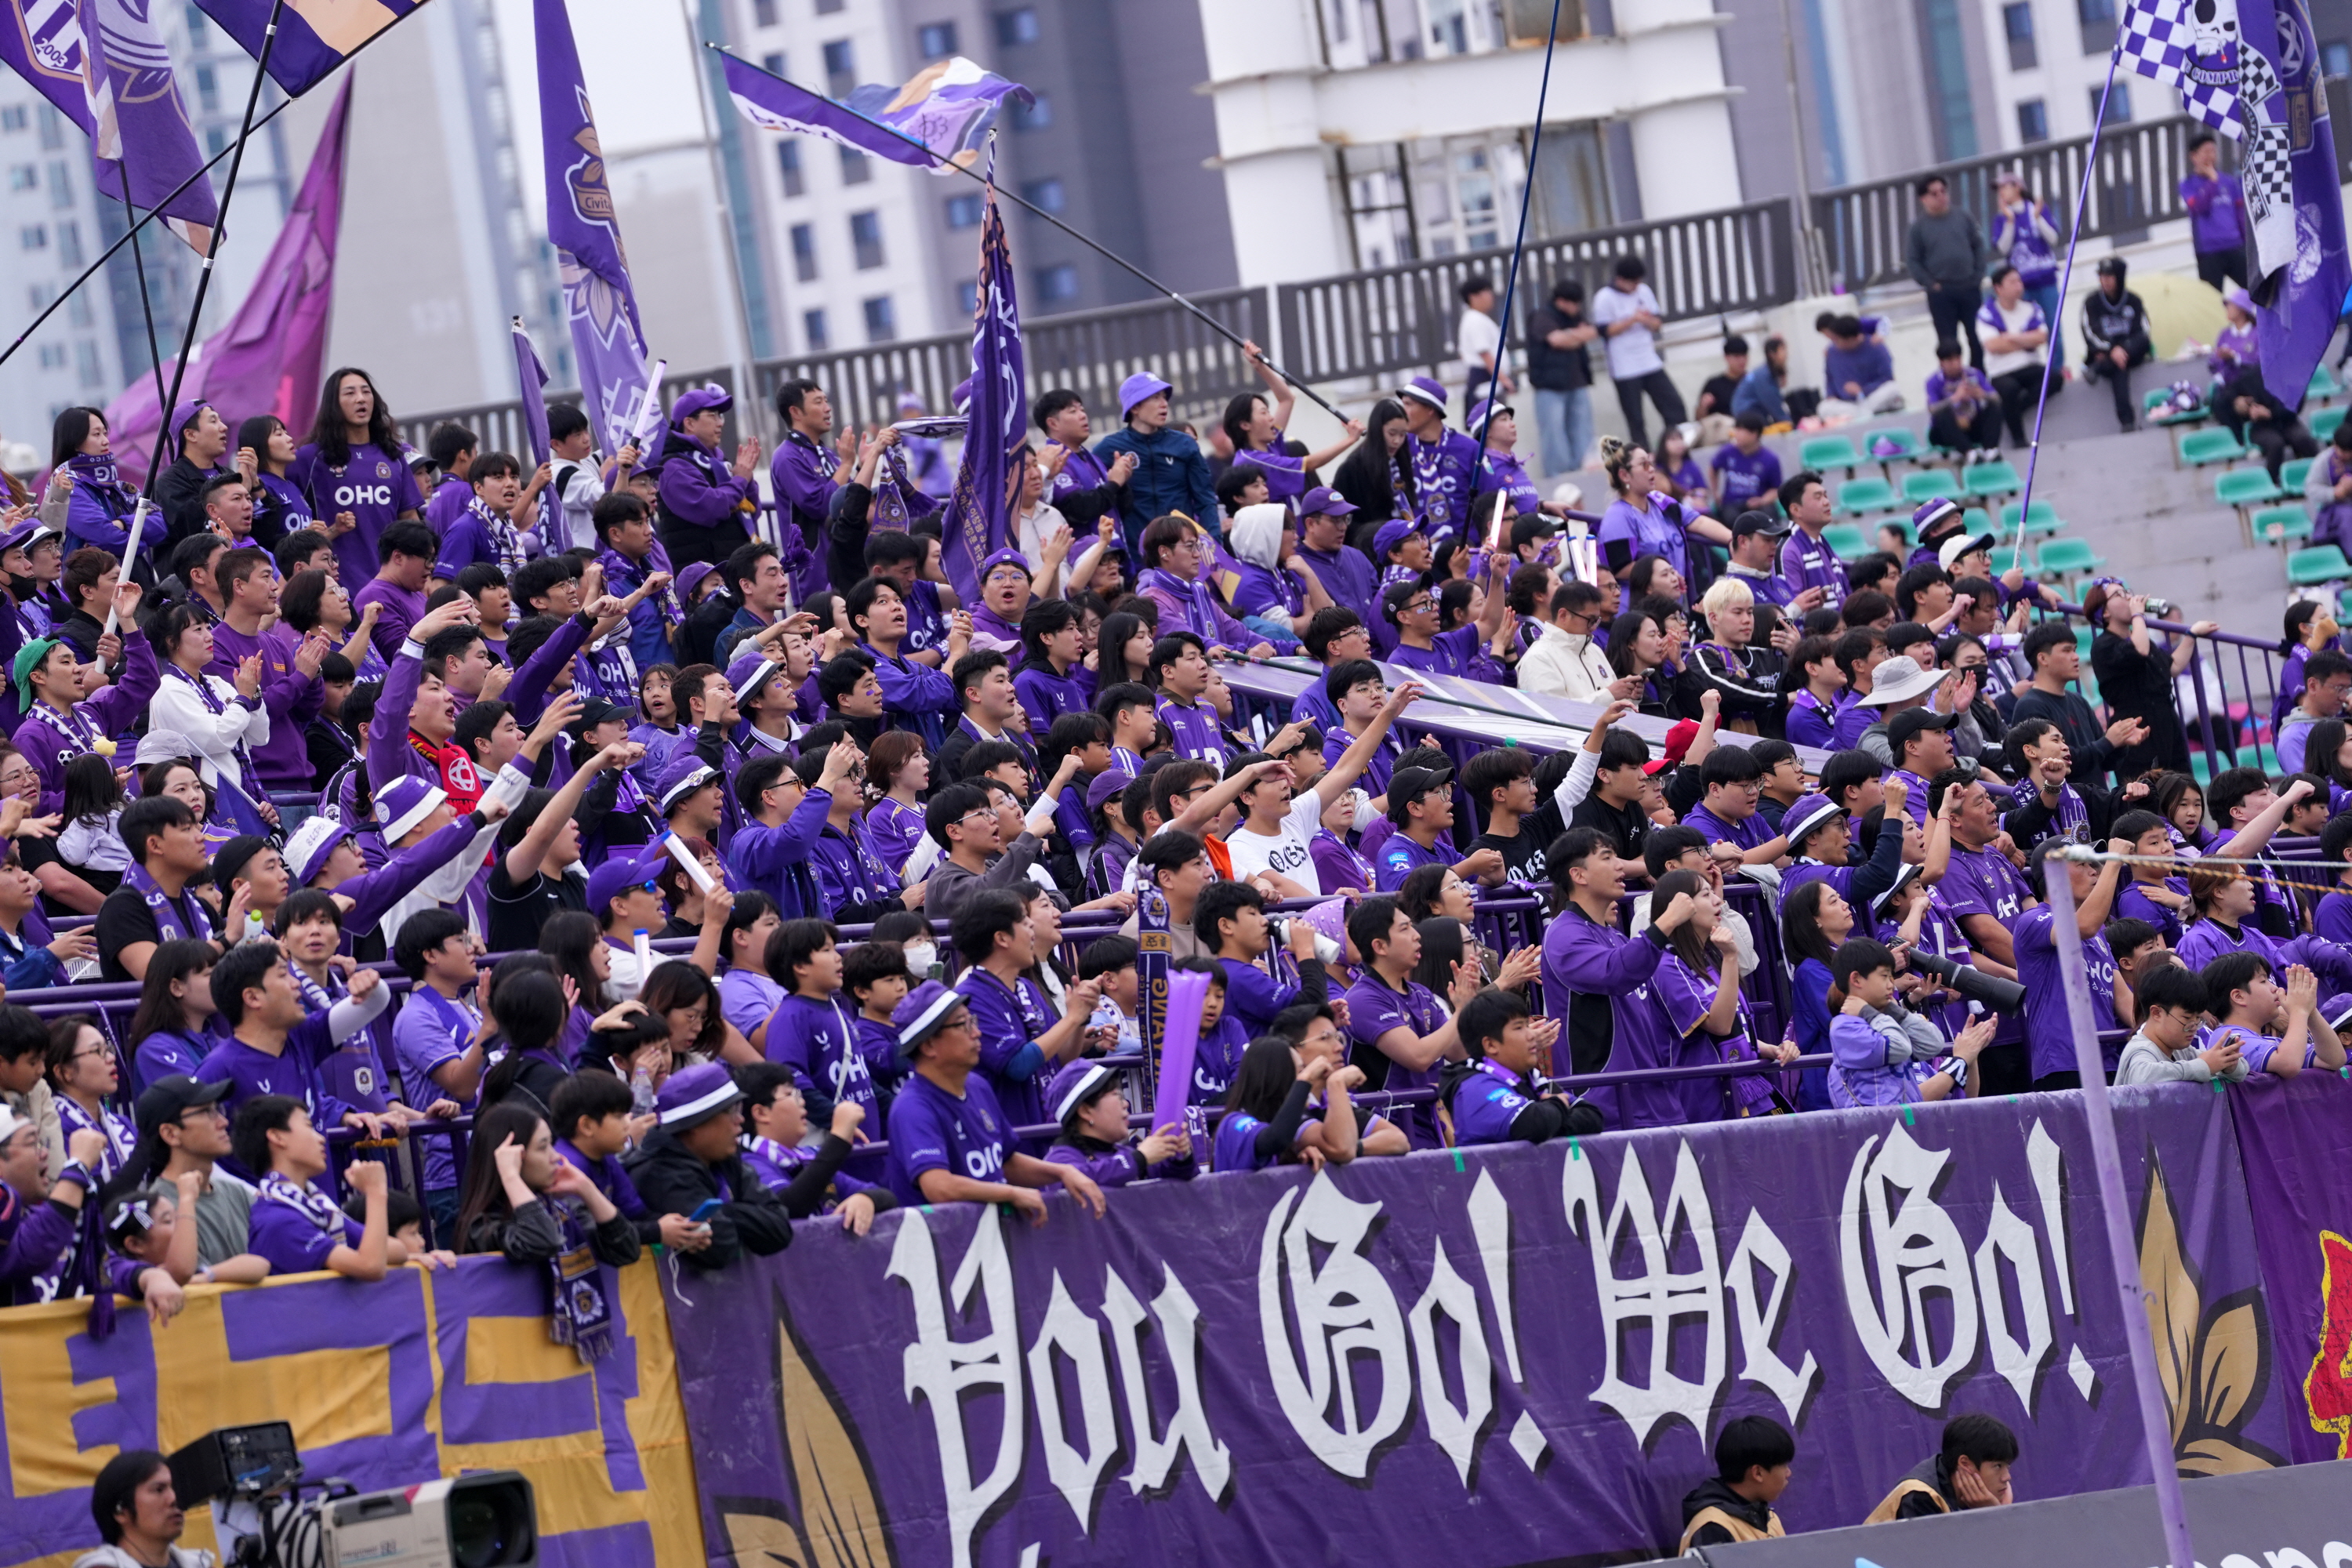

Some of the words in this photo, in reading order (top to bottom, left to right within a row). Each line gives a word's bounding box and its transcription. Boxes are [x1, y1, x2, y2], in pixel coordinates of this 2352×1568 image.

[35, 38, 68, 68] 2003
[89, 452, 114, 463] ELICO
[335, 485, 391, 506] OHC
[285, 512, 312, 530] OH
[597, 662, 626, 683] OH
[1069, 828, 1087, 837] ANYANG
[1951, 899, 1974, 909] ANYANG
[884, 1202, 1231, 1568] You
[1258, 1168, 1548, 1490] Go!
[1562, 1137, 1817, 1455] We
[1839, 1116, 2096, 1418] Go!
